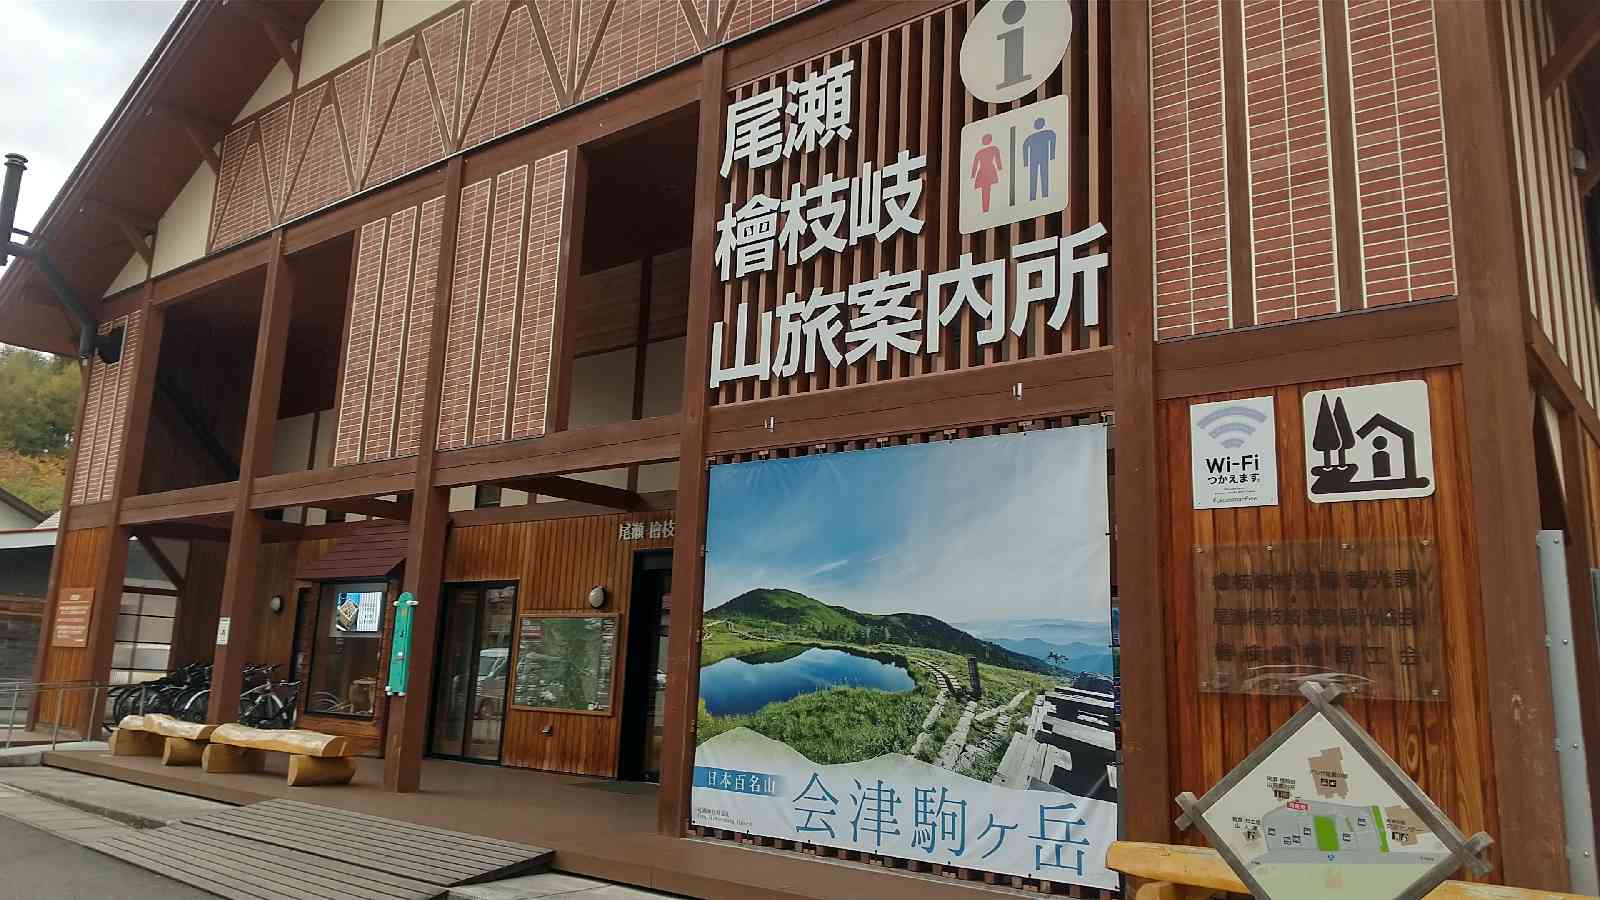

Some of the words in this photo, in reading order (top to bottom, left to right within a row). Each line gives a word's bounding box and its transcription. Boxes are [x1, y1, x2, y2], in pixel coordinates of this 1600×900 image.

[720, 60, 855, 179] 尾瀬
[714, 150, 927, 282] 檜枝岐
[709, 222, 1109, 389] 山旅案内所
[1206, 454, 1259, 473] Wi-Fi
[708, 770, 776, 793] 日本百名山
